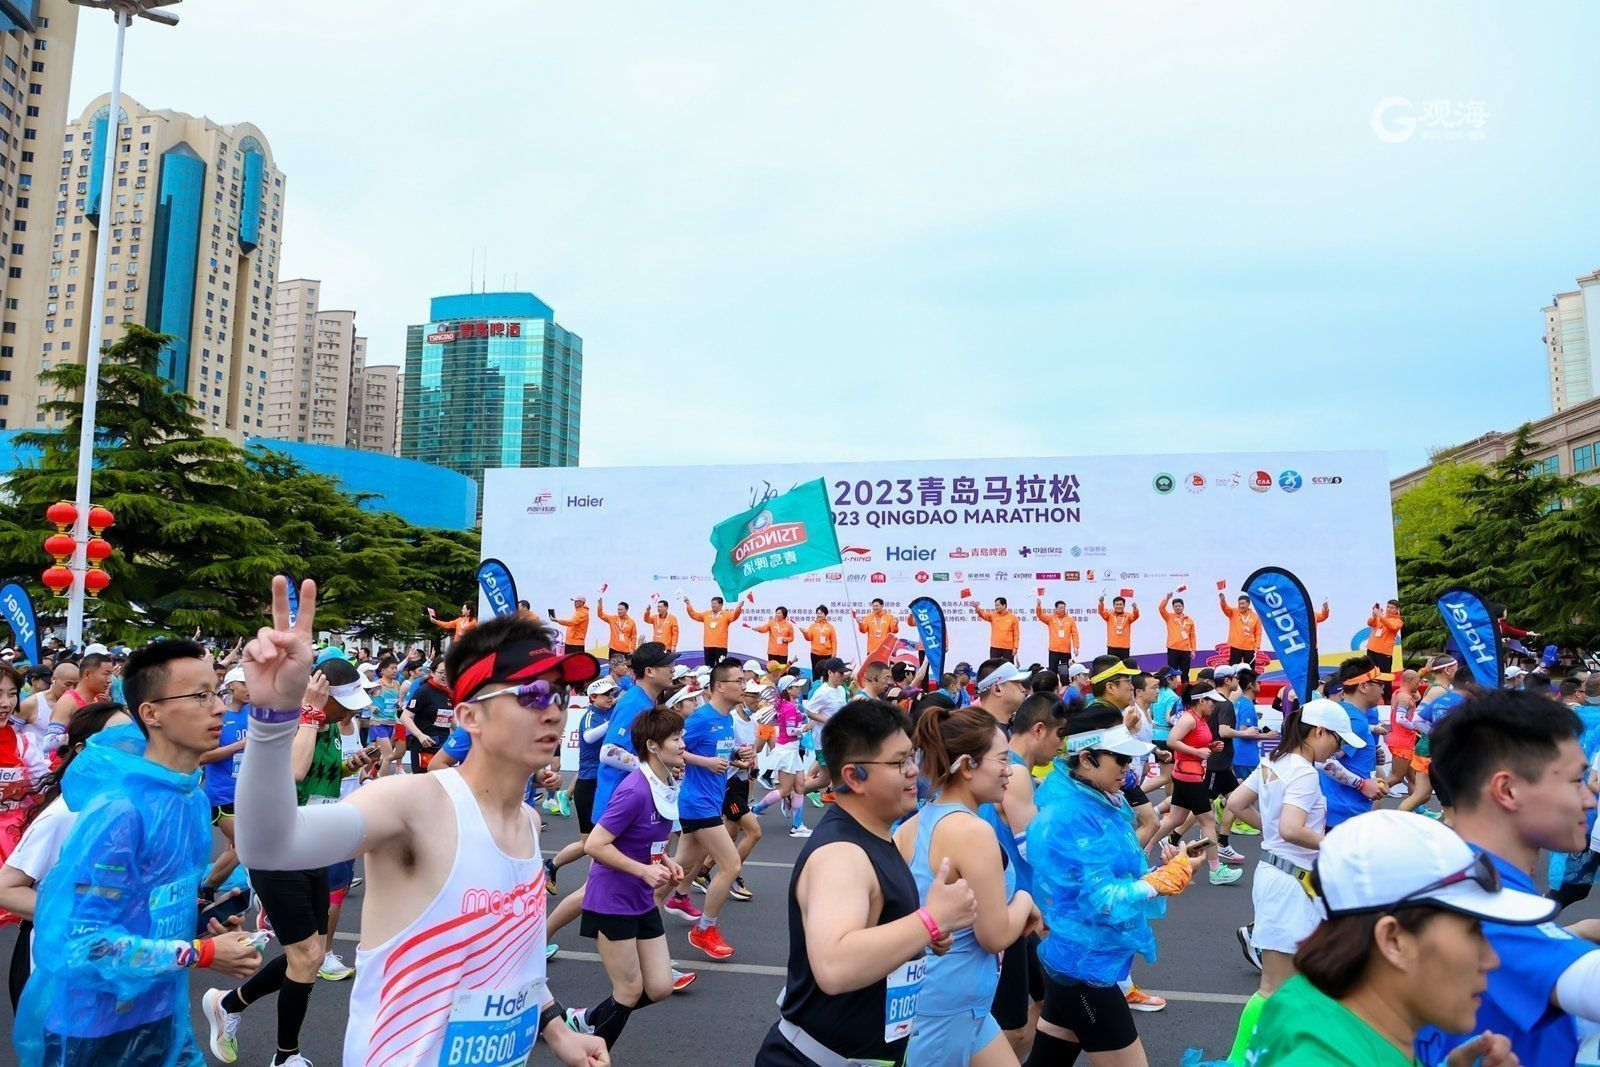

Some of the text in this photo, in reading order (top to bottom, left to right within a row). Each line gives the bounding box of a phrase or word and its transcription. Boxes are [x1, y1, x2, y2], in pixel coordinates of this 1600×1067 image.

[429, 333, 454, 342] TSINGTAO
[460, 323, 521, 338] 青岛啤酒
[834, 473, 1081, 507] 2023青岛马拉松
[567, 495, 604, 507] Haier
[831, 507, 1081, 528] 023 QINGDAO MARATHON
[886, 545, 937, 561] Haier
[971, 547, 1007, 557] 青岛啤酒
[3, 593, 34, 643] Haier
[1258, 585, 1306, 655] Haier
[1445, 602, 1495, 664] Haier
[0, 771, 16, 780] ier
[890, 994, 917, 1020] B103
[448, 1030, 516, 1065] B13600
